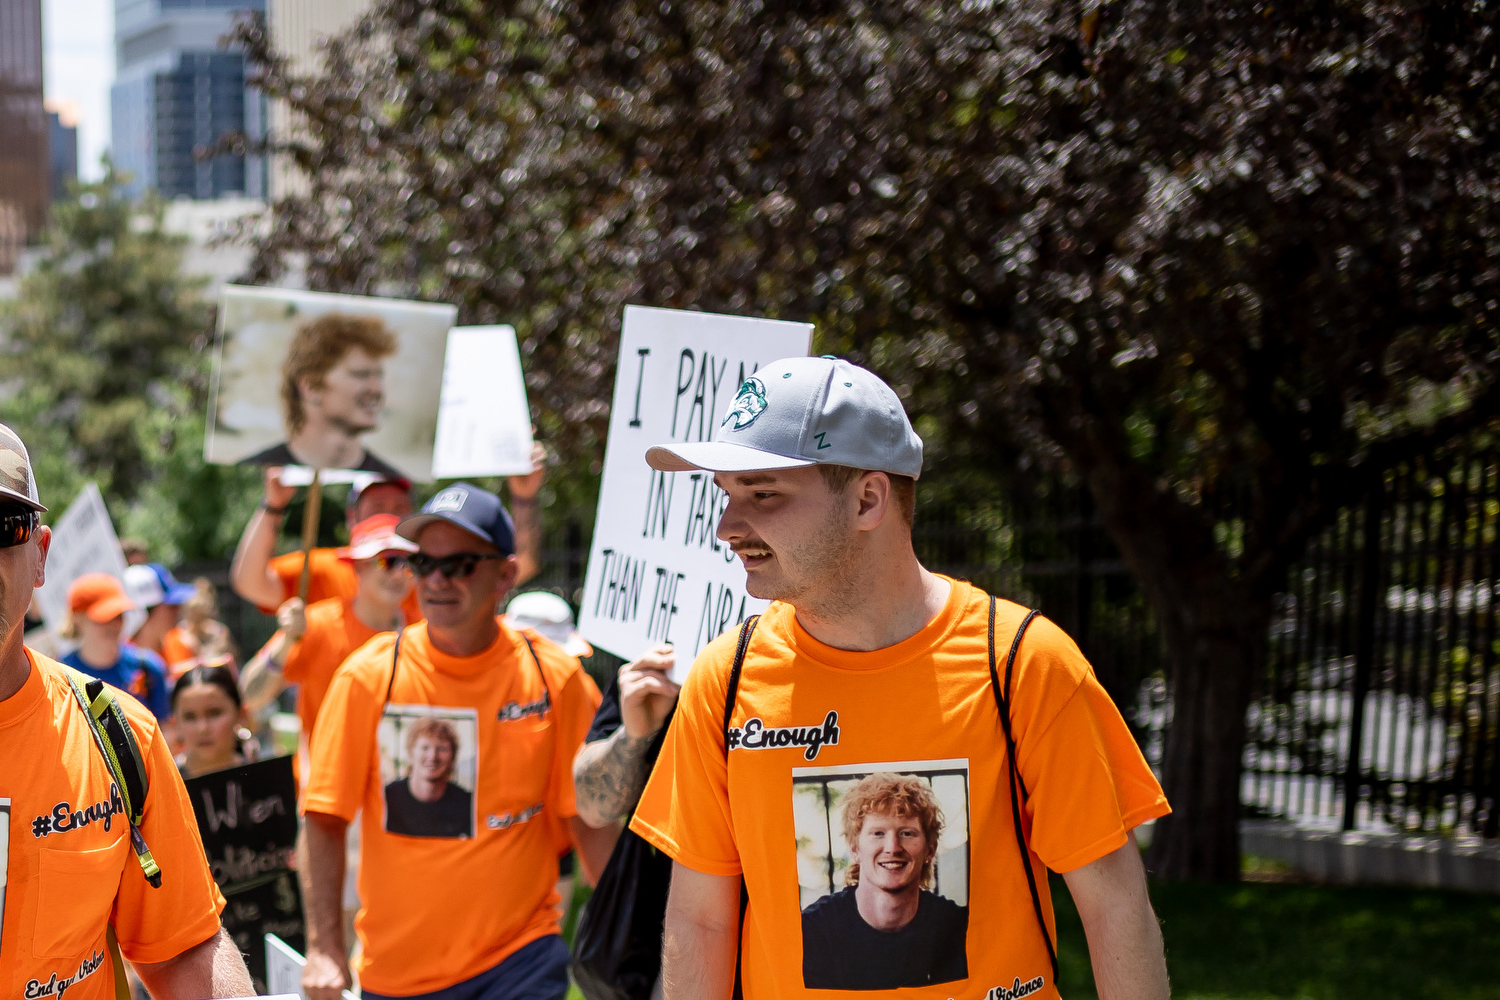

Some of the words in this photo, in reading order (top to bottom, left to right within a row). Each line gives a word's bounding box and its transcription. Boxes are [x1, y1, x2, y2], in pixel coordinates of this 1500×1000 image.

[628, 348, 650, 428] I
[671, 348, 728, 442] PAY
[642, 467, 675, 539] IN
[684, 474, 736, 563] TAXE
[595, 549, 647, 623] THAN
[647, 567, 686, 645] THE
[727, 710, 839, 760] #Enough
[25, 972, 57, 999] End
